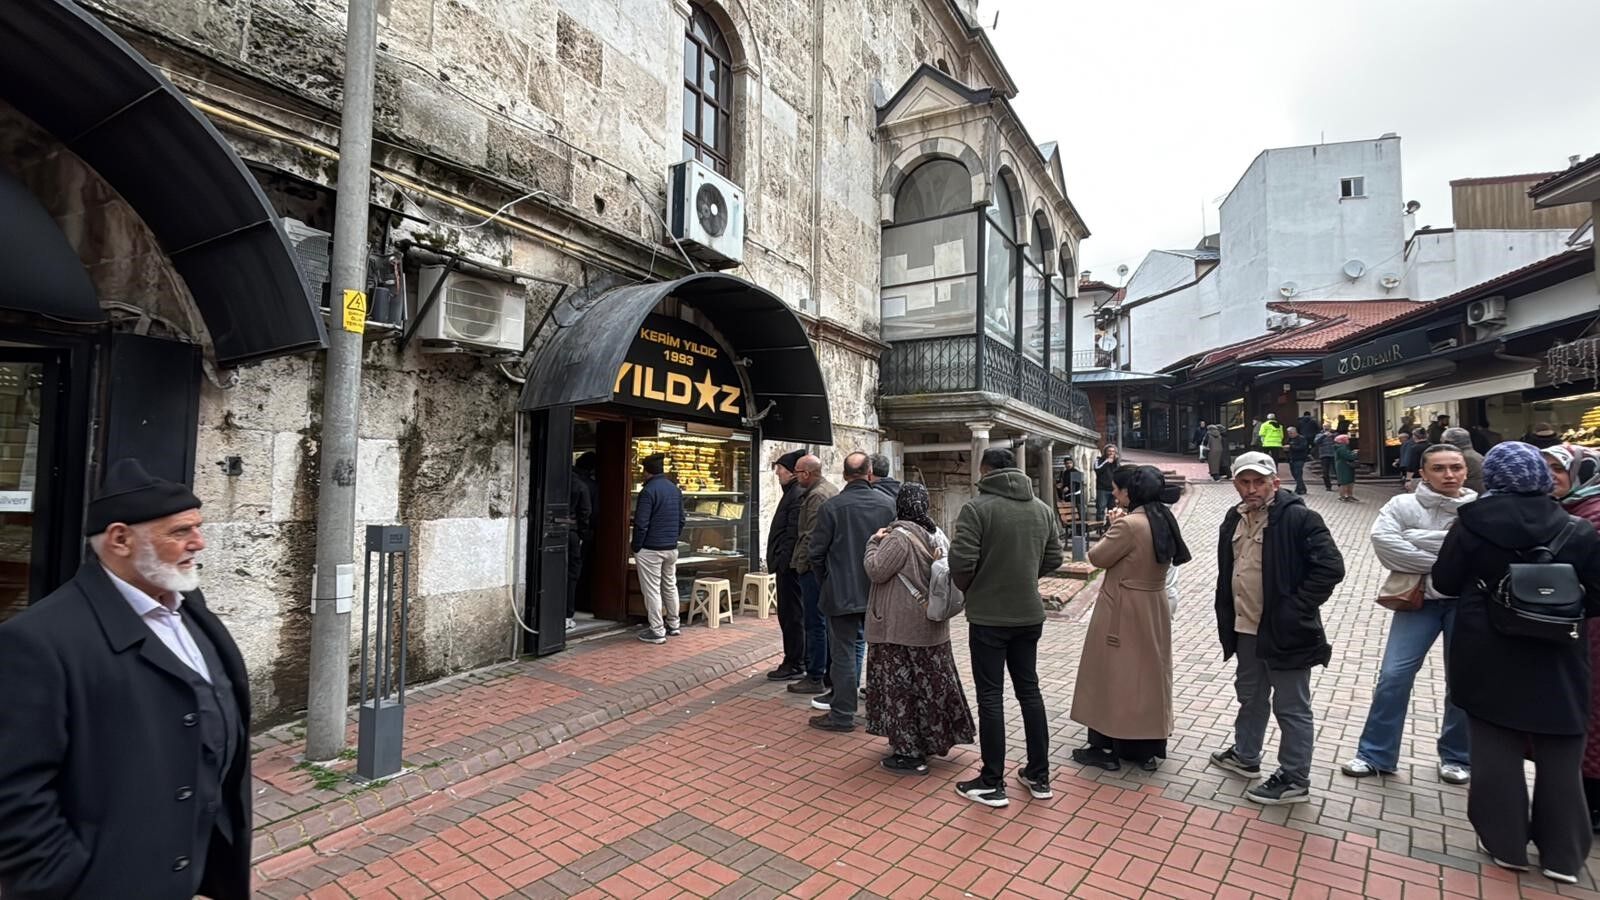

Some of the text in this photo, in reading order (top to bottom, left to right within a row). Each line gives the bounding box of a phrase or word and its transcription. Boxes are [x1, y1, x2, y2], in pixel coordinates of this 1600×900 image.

[640, 327, 718, 358] KERİM YILDIZ
[663, 350, 694, 366] 1993
